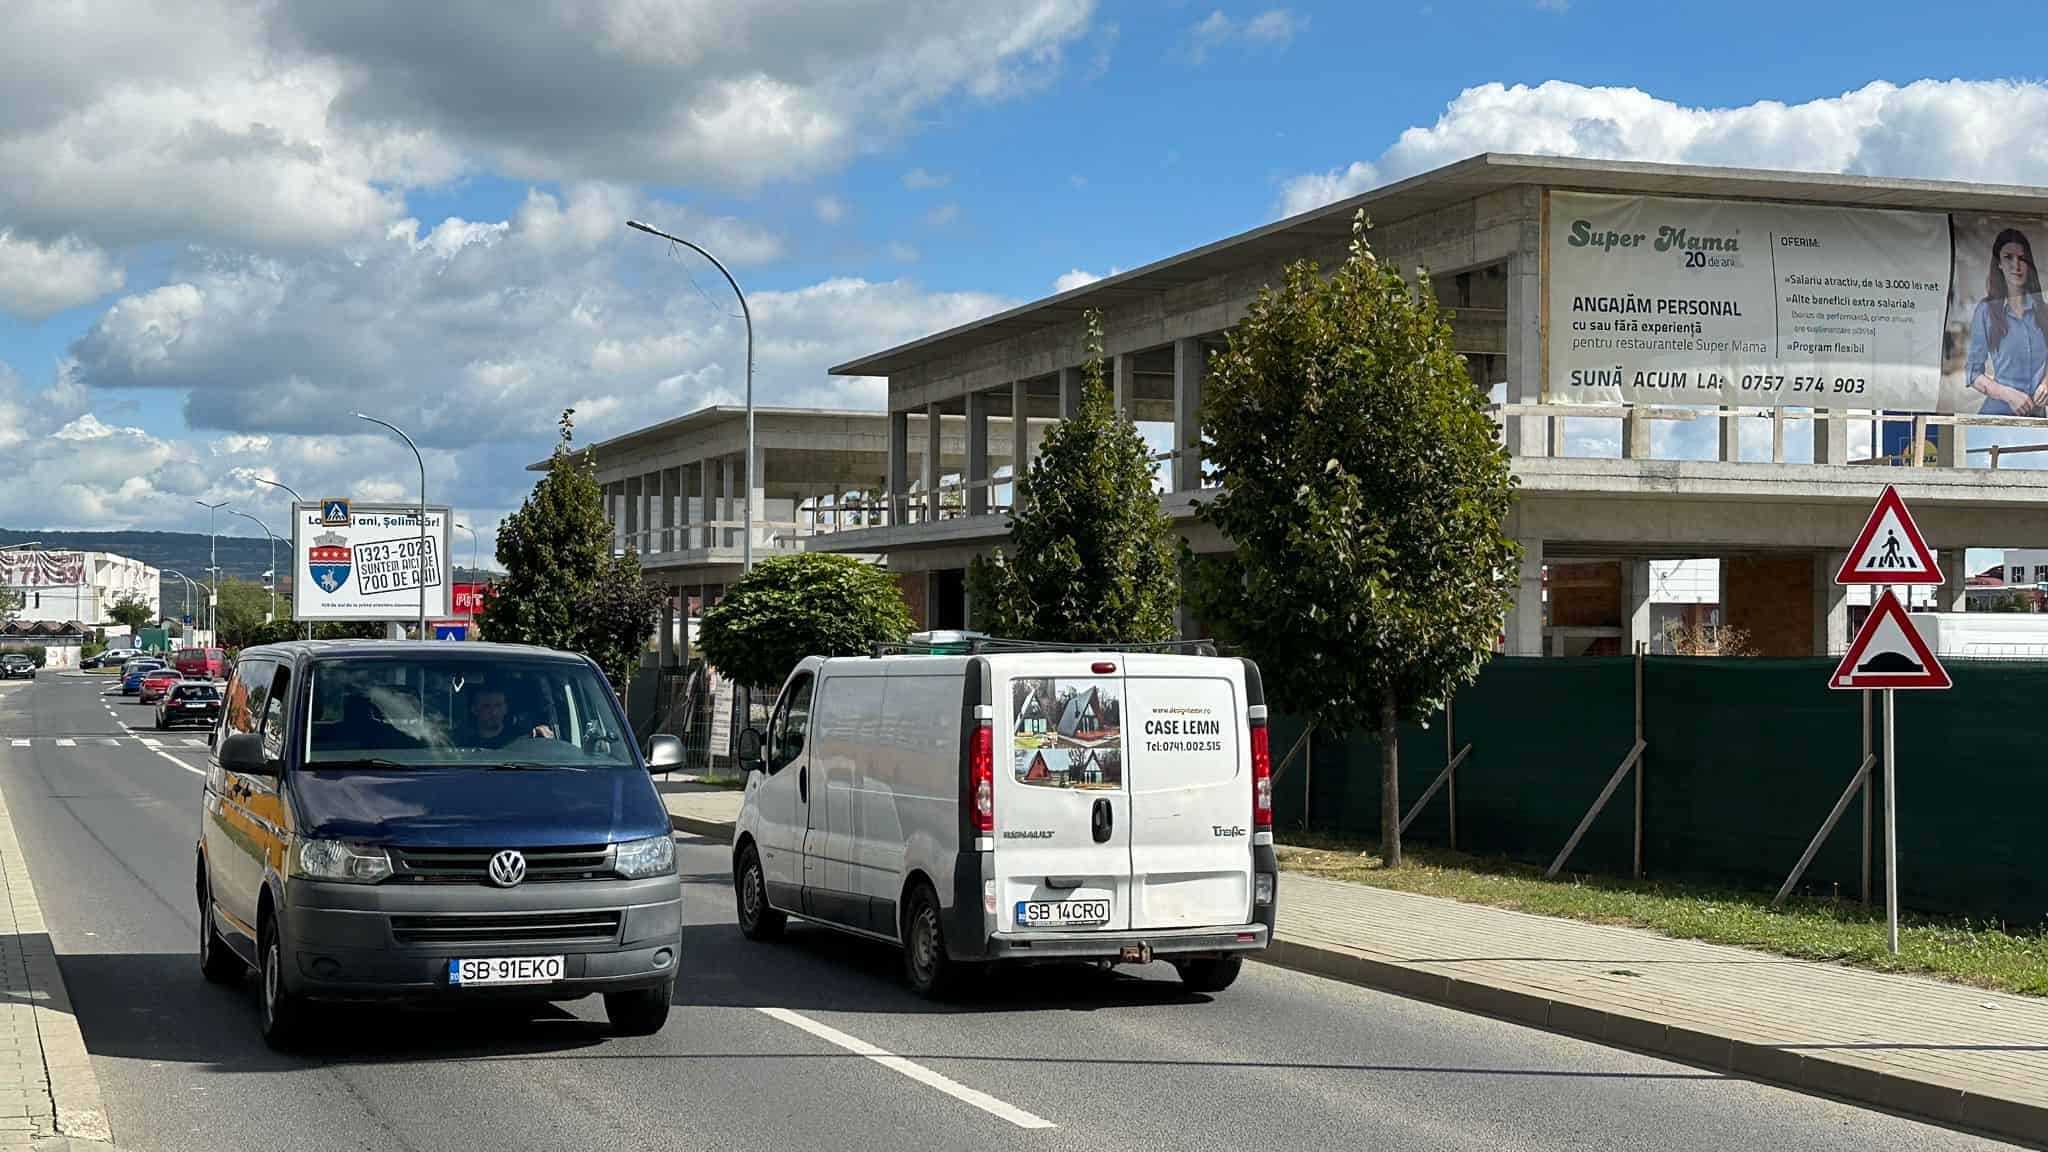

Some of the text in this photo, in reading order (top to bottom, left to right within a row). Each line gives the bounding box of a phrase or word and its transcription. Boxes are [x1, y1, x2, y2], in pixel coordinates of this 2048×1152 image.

[1568, 220, 1739, 252] Super Mama
[1685, 252, 1706, 267] 20
[1708, 257, 1719, 267] de
[1824, 276, 1860, 288] atractiv,
[1862, 278, 1873, 287] de
[1875, 279, 1883, 288] la
[1885, 280, 1910, 289] 3.000
[1912, 281, 1922, 290] lei
[1924, 282, 1939, 291] net
[1573, 294, 1742, 316] ANGAJĂM PERSONAL
[1812, 296, 1850, 306] beneficii
[1852, 297, 1875, 307] extra
[1878, 298, 1915, 309] salariale
[1573, 321, 1586, 331] cu
[1590, 321, 1611, 332] sau
[1614, 320, 1638, 332] fără
[1573, 337, 1767, 354] pentru restaurantele Super Mama
[1835, 343, 1864, 353] flexibil
[1571, 366, 1865, 393] SUNĂ ACUM LA: 0757 574 903
[359, 516, 381, 527] ani,
[361, 560, 399, 575] SUNTEM
[402, 557, 420, 571] AICI
[362, 574, 388, 591] 700
[393, 572, 408, 587] DE
[1145, 720, 1219, 735] CASE LEMN
[1028, 903, 1105, 920] SB 14CRO
[463, 959, 560, 980] SB 91EKO
